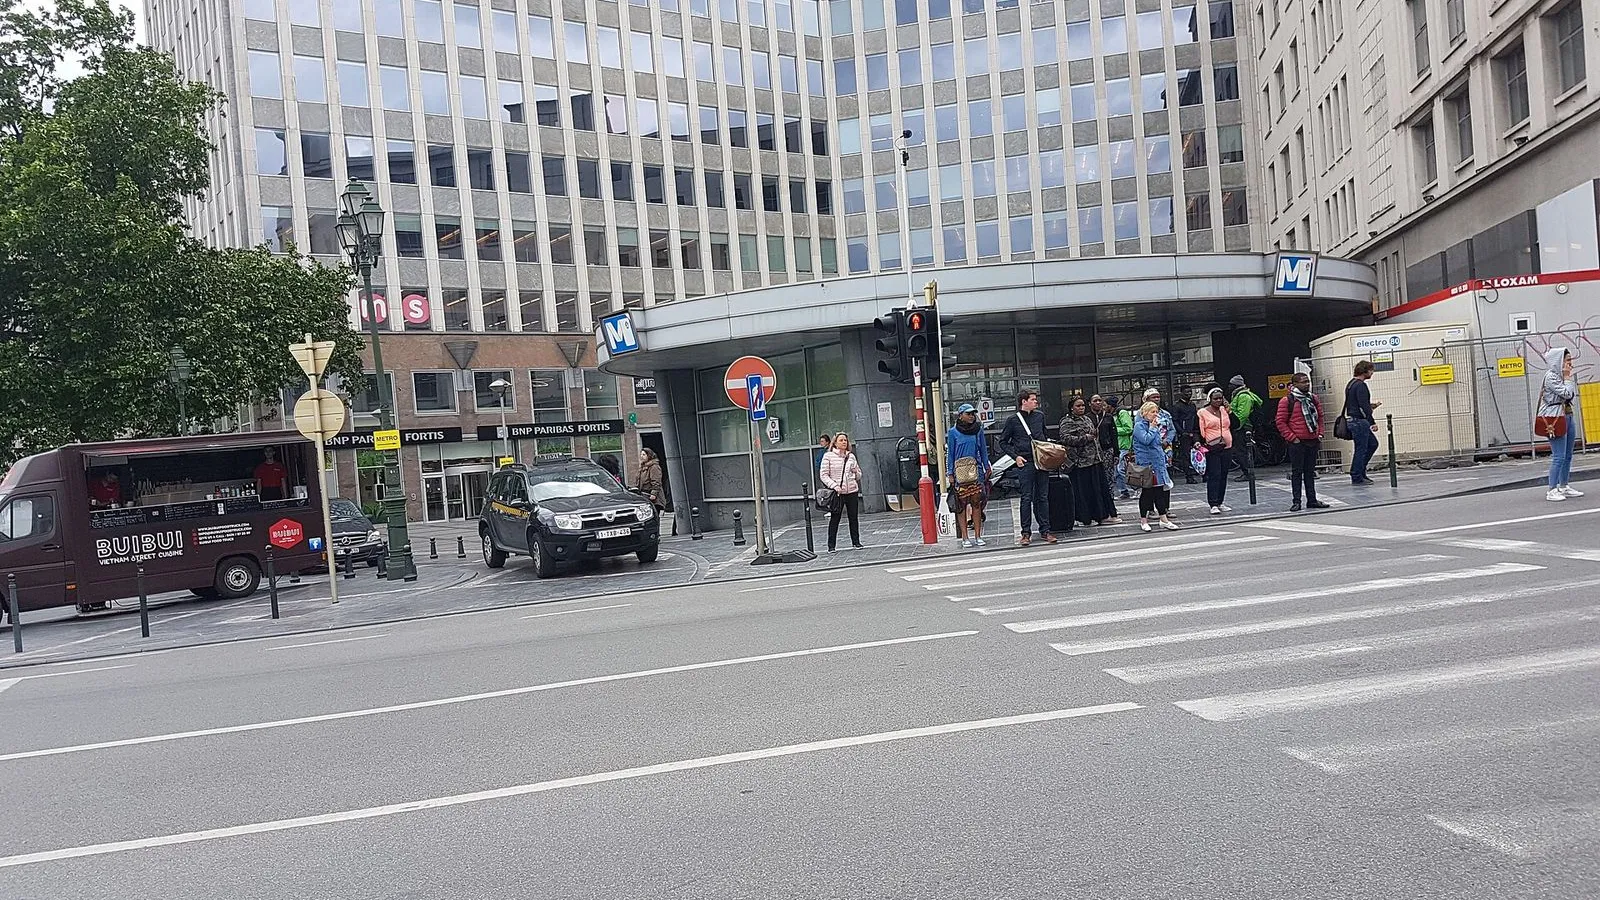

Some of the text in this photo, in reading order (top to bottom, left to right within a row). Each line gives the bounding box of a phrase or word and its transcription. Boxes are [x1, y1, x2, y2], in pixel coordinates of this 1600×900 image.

[1278, 258, 1312, 289] M
[1494, 276, 1539, 288] LOXAM
[605, 317, 636, 350] M
[1356, 337, 1400, 349] electro 80
[1500, 362, 1523, 370] METRO
[512, 422, 611, 436] BNP PARIBAS FORTIS
[324, 435, 349, 446] BNP
[405, 431, 445, 442] FORTIS
[376, 434, 398, 443] METRO
[96, 530, 184, 558] BUIBUI
[98, 549, 184, 566] VIETNAM STREET CUISINE
